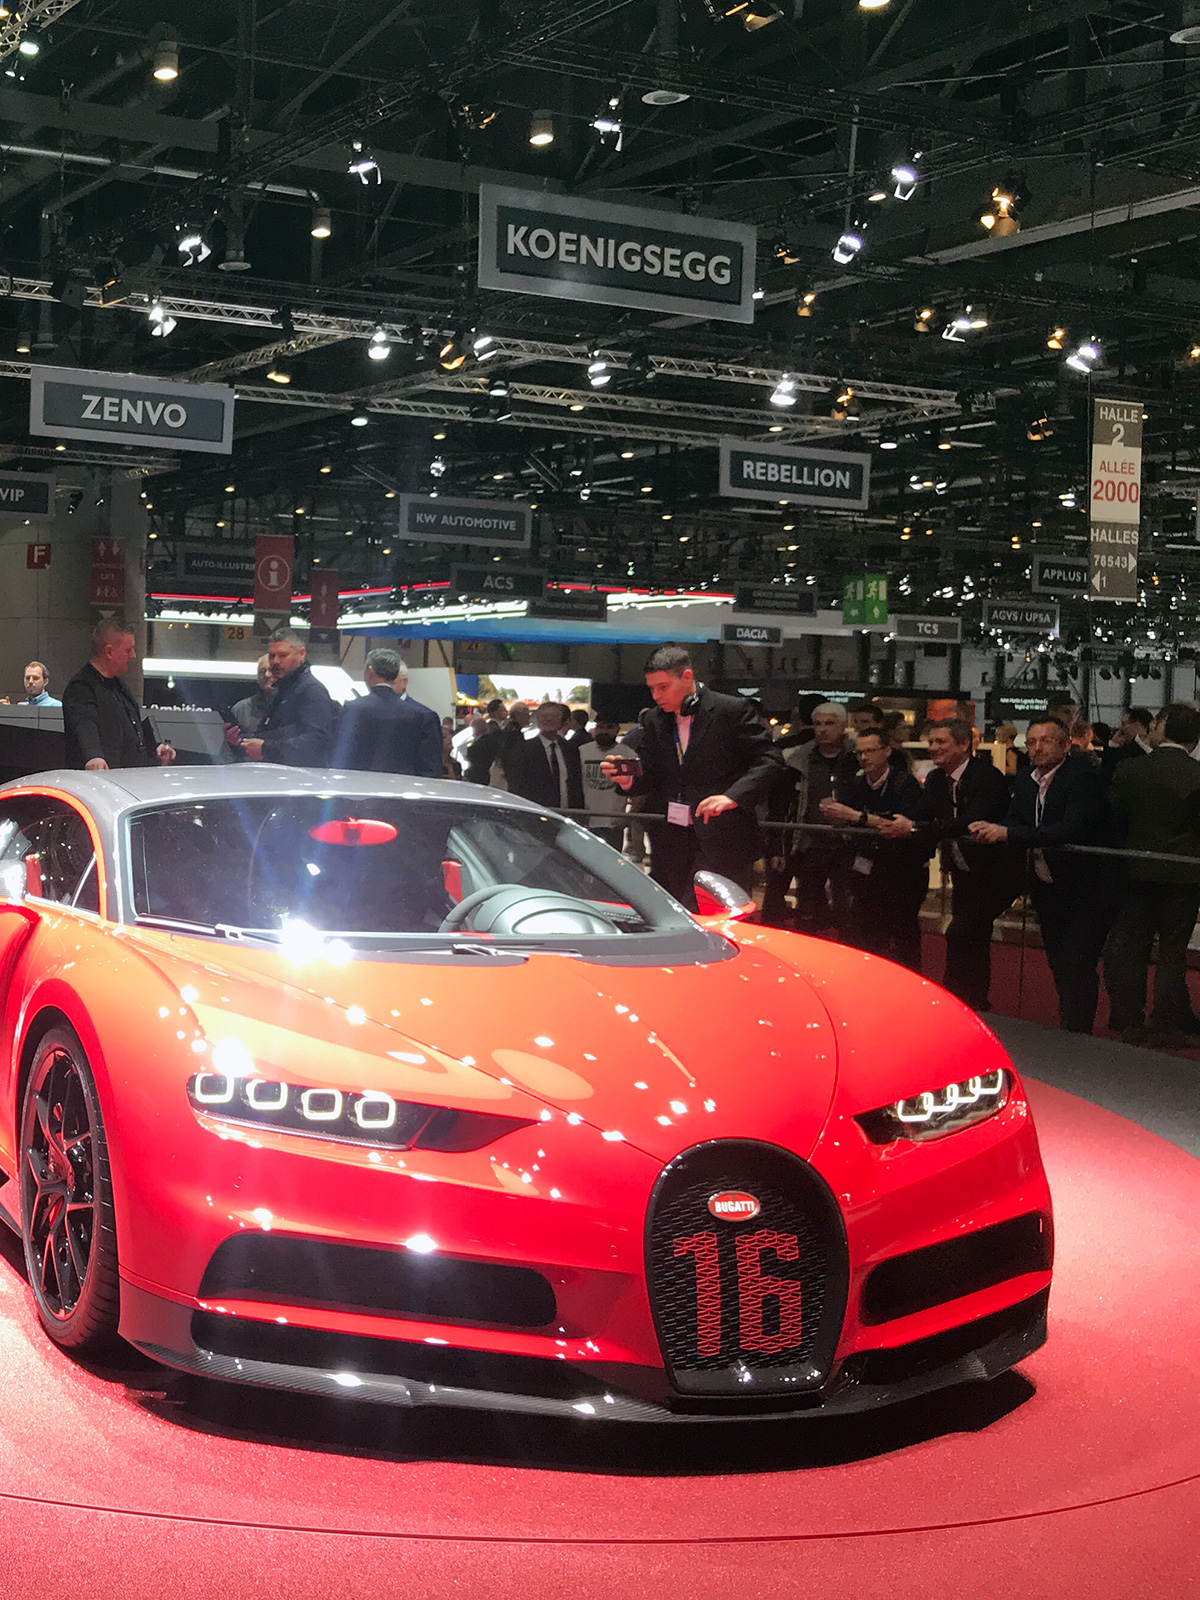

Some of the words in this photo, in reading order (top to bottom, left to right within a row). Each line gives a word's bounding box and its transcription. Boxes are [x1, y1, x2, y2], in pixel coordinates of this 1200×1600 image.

[507, 223, 731, 285] KOENIGSEGG
[81, 394, 187, 430] ZENVO
[1100, 407, 1139, 423] HALLE
[1112, 423, 1125, 446] 2
[1099, 459, 1135, 475] ALLÉE
[742, 461, 850, 491] REBELLION
[1093, 479, 1140, 504] 2000
[416, 512, 436, 524] KW
[441, 515, 516, 531] AUTOMOTIVE
[1091, 528, 1139, 545] HALLES
[33, 546, 46, 563] F
[483, 574, 514, 590] ACS
[1043, 568, 1081, 583] APPLUS
[1025, 612, 1051, 624] UPSA
[228, 628, 245, 640] 28
[736, 627, 768, 640] DACIA
[916, 622, 939, 634] TCS
[715, 1200, 755, 1213] BUGATTI
[673, 1229, 802, 1357] 16
